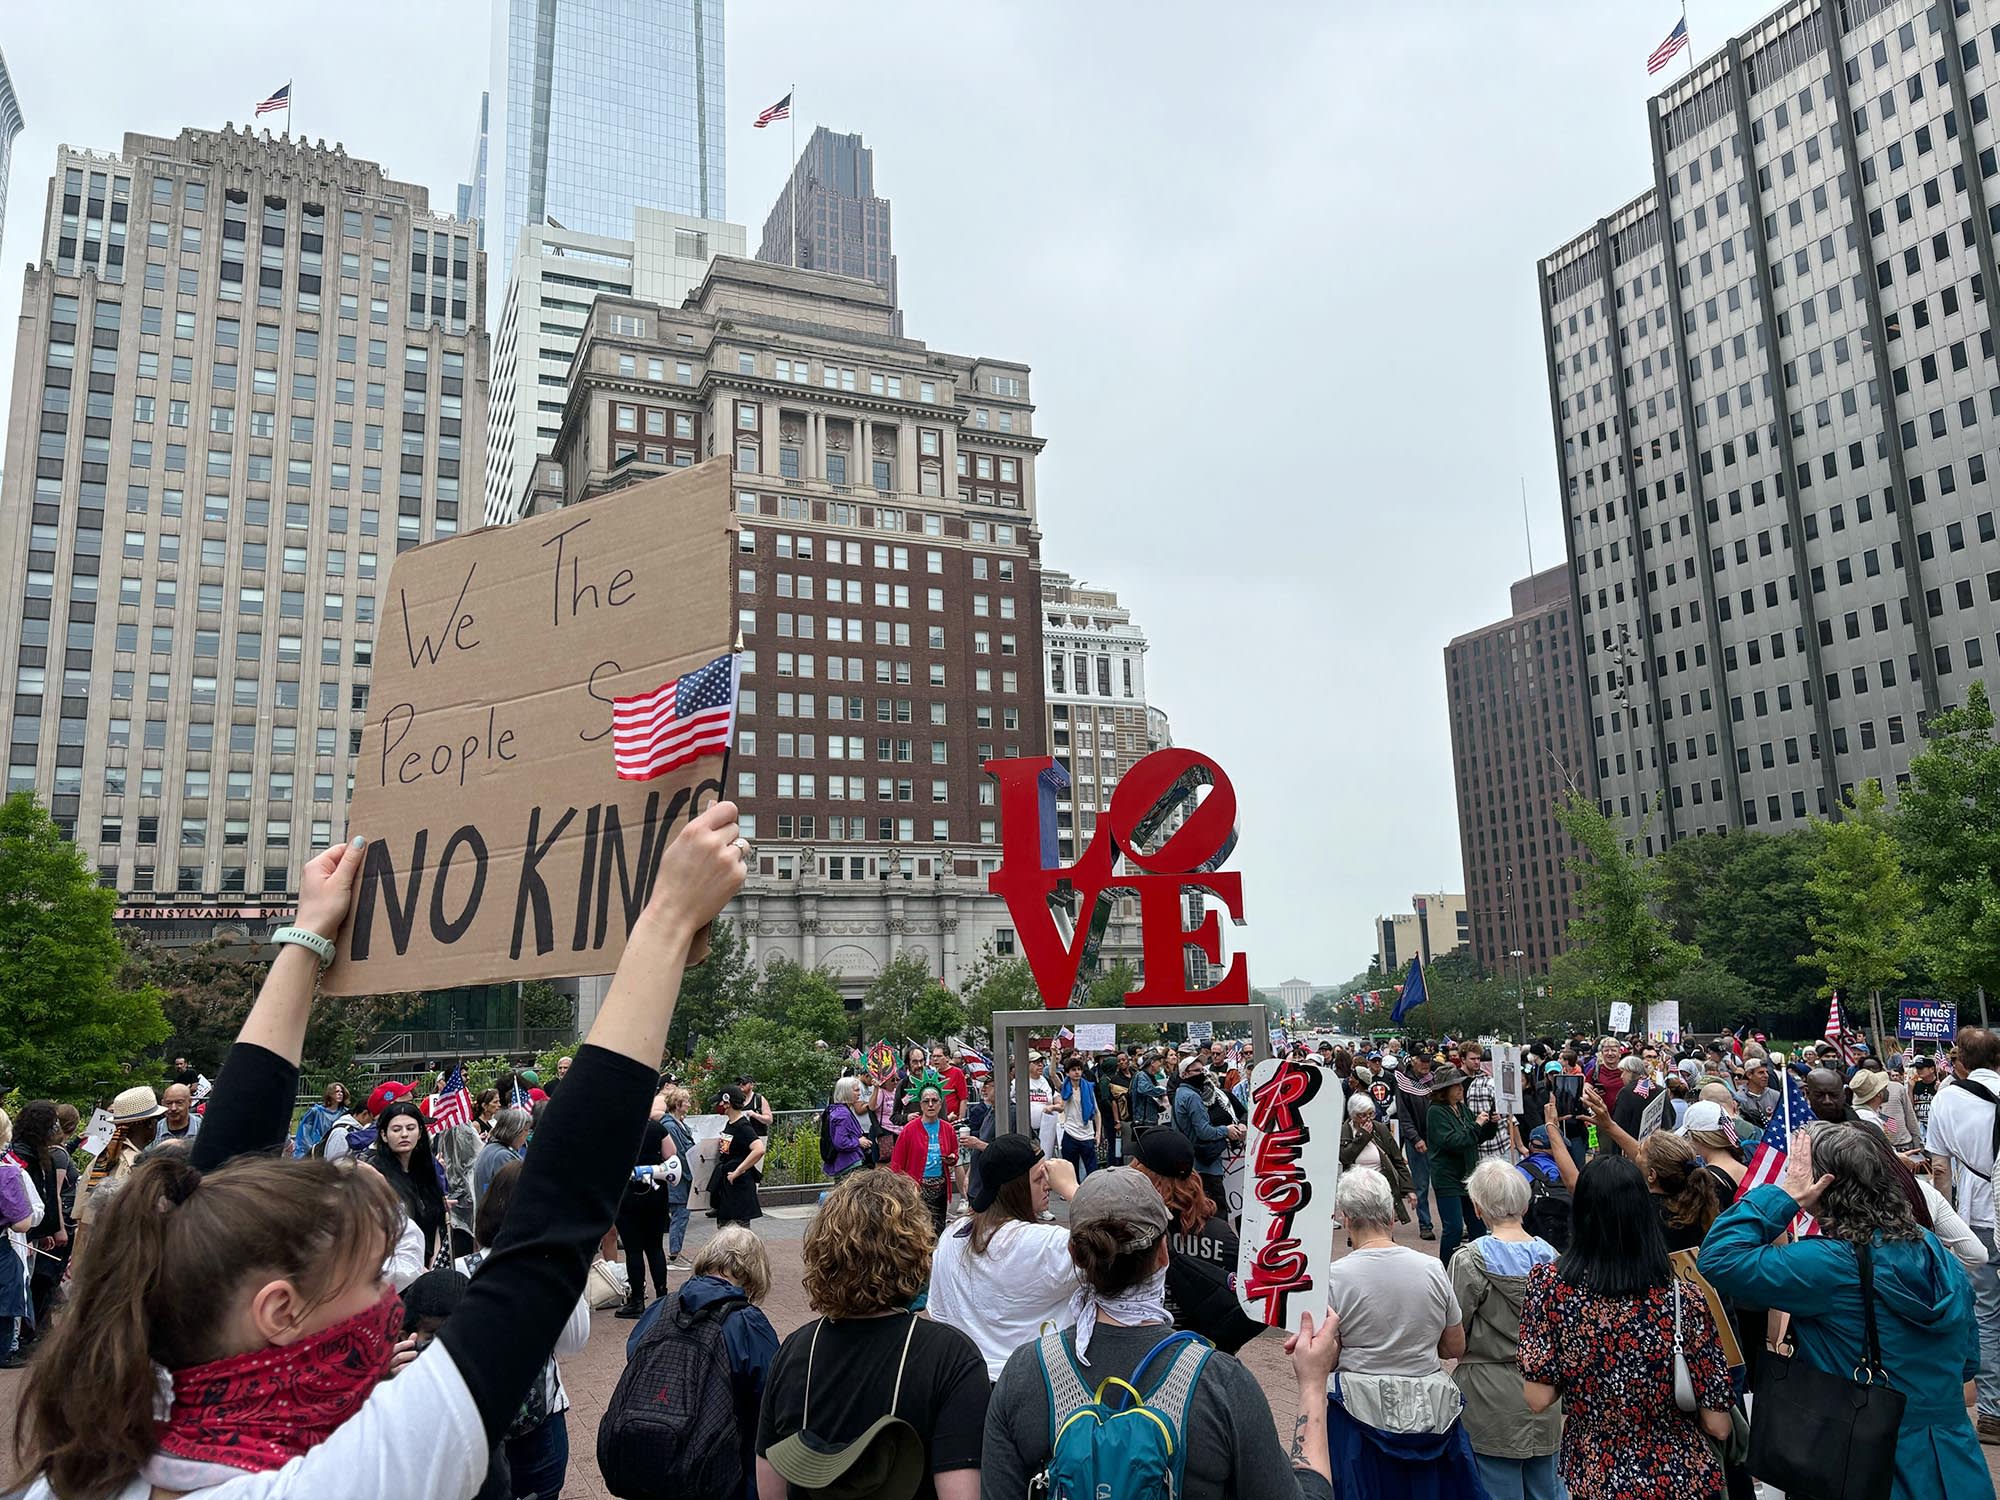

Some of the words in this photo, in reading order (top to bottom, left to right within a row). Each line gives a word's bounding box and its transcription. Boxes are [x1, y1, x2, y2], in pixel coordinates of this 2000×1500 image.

[401, 562, 480, 668] We
[542, 519, 636, 626] The
[380, 703, 517, 786] People
[123, 909, 241, 918] PENNSYLVANIA
[351, 825, 488, 960] NO
[1904, 1007, 1919, 1017] NO
[1920, 1008, 1950, 1018] KINGS
[1904, 1022, 1950, 1033] AMERICA
[1245, 1061, 1323, 1329] RESIST
[1173, 1232, 1225, 1262] OUSE
